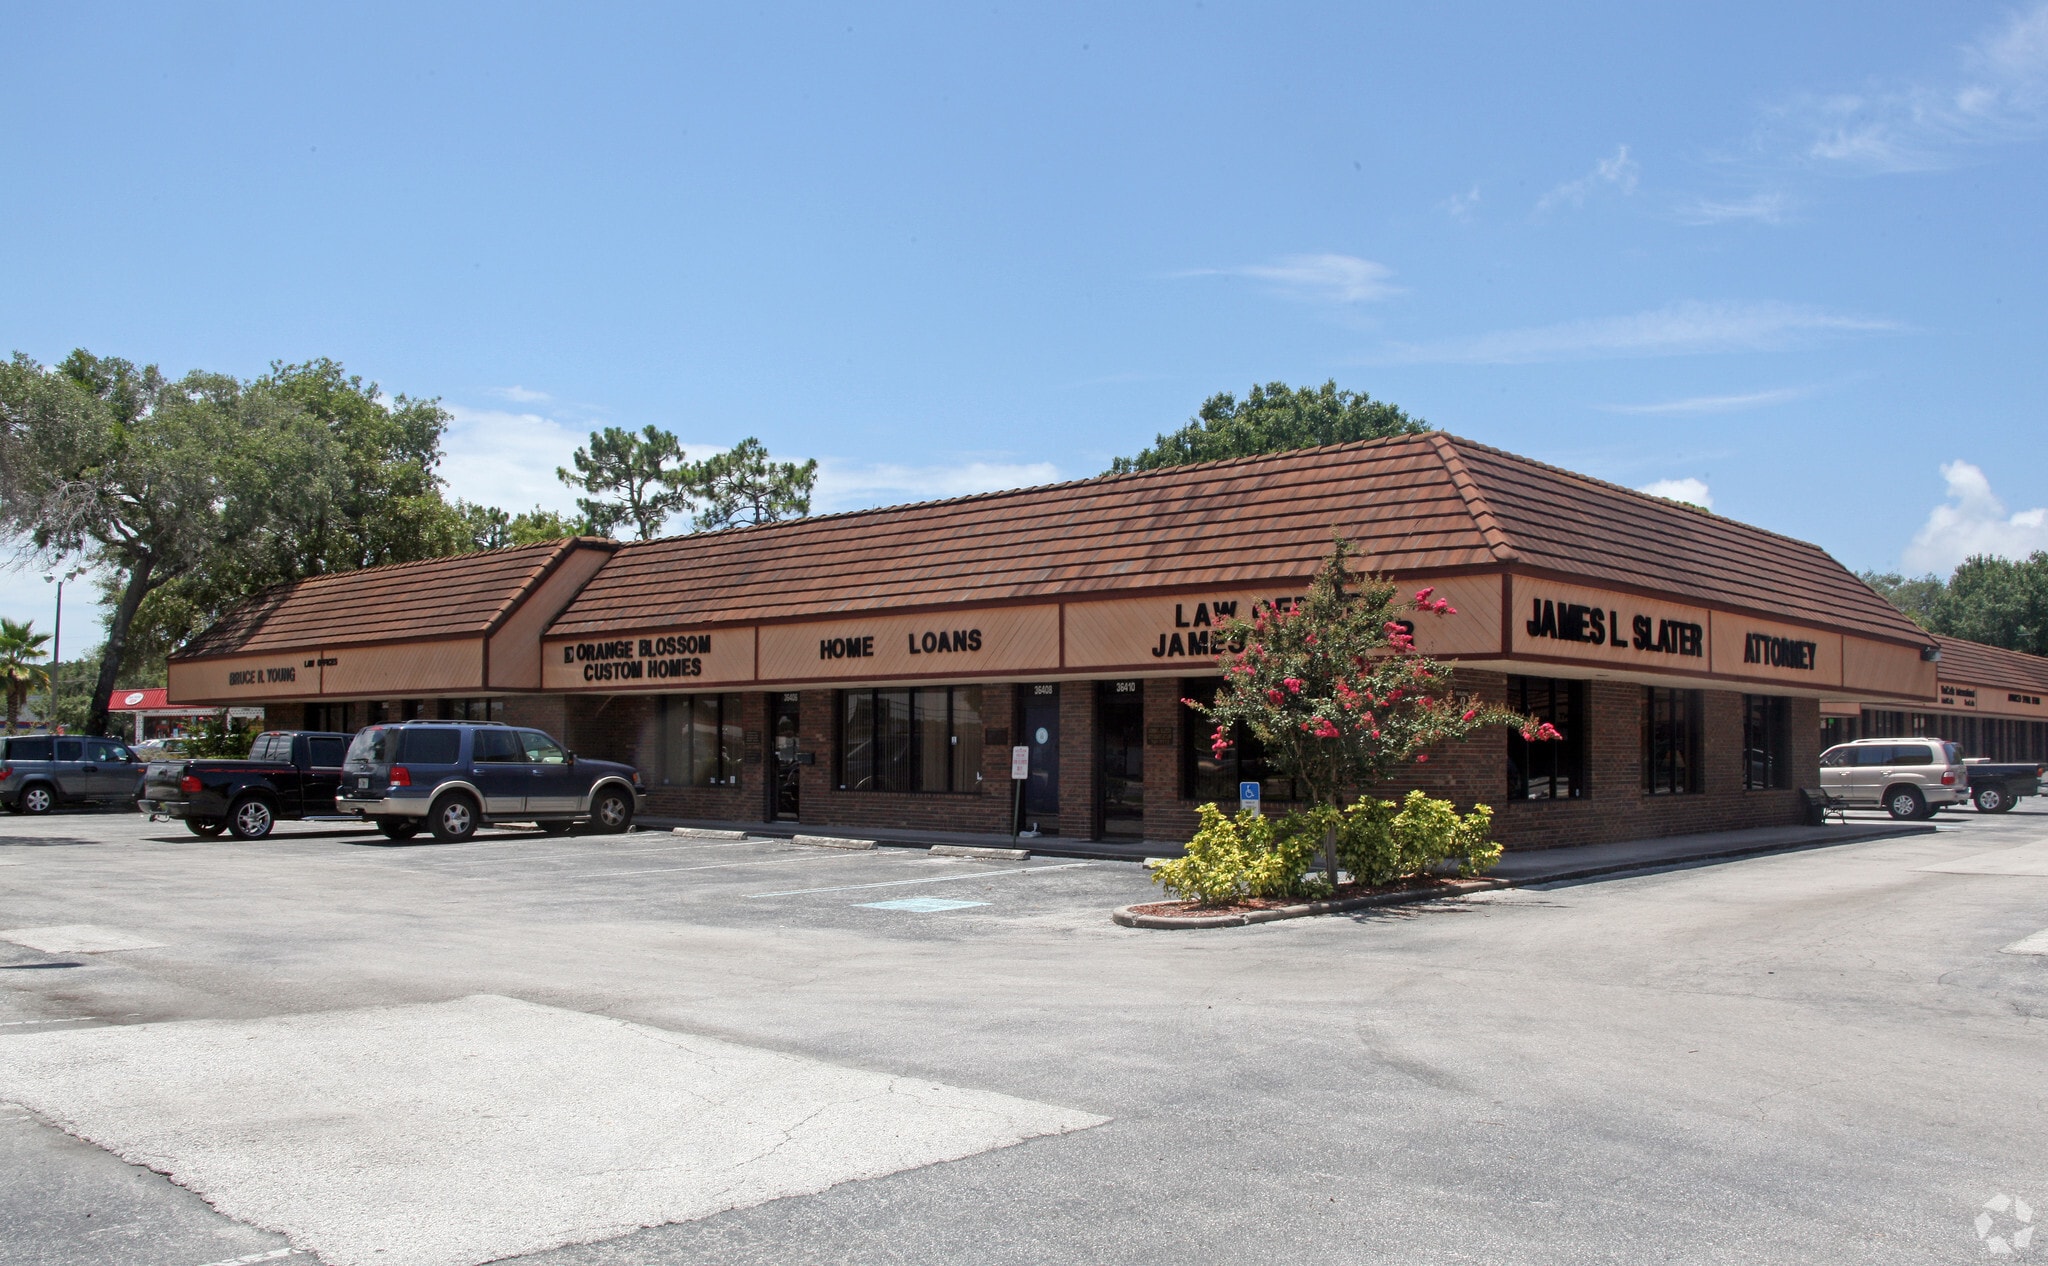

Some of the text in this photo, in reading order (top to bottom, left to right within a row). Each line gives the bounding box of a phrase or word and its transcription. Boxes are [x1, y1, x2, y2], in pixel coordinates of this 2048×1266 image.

[1175, 601, 1238, 628] LAW
[1526, 598, 1606, 645] JAMES
[1632, 614, 1703, 657] SLATER
[576, 634, 711, 661] ORANGE BLOSSOM
[820, 629, 982, 660] HOME LOANS
[1743, 632, 1817, 671] ATTORNEY
[229, 670, 256, 686] BRUCE
[267, 667, 296, 683] YOUNG
[583, 657, 702, 682] CUSTOM HOMES
[1116, 682, 1136, 692] 36410
